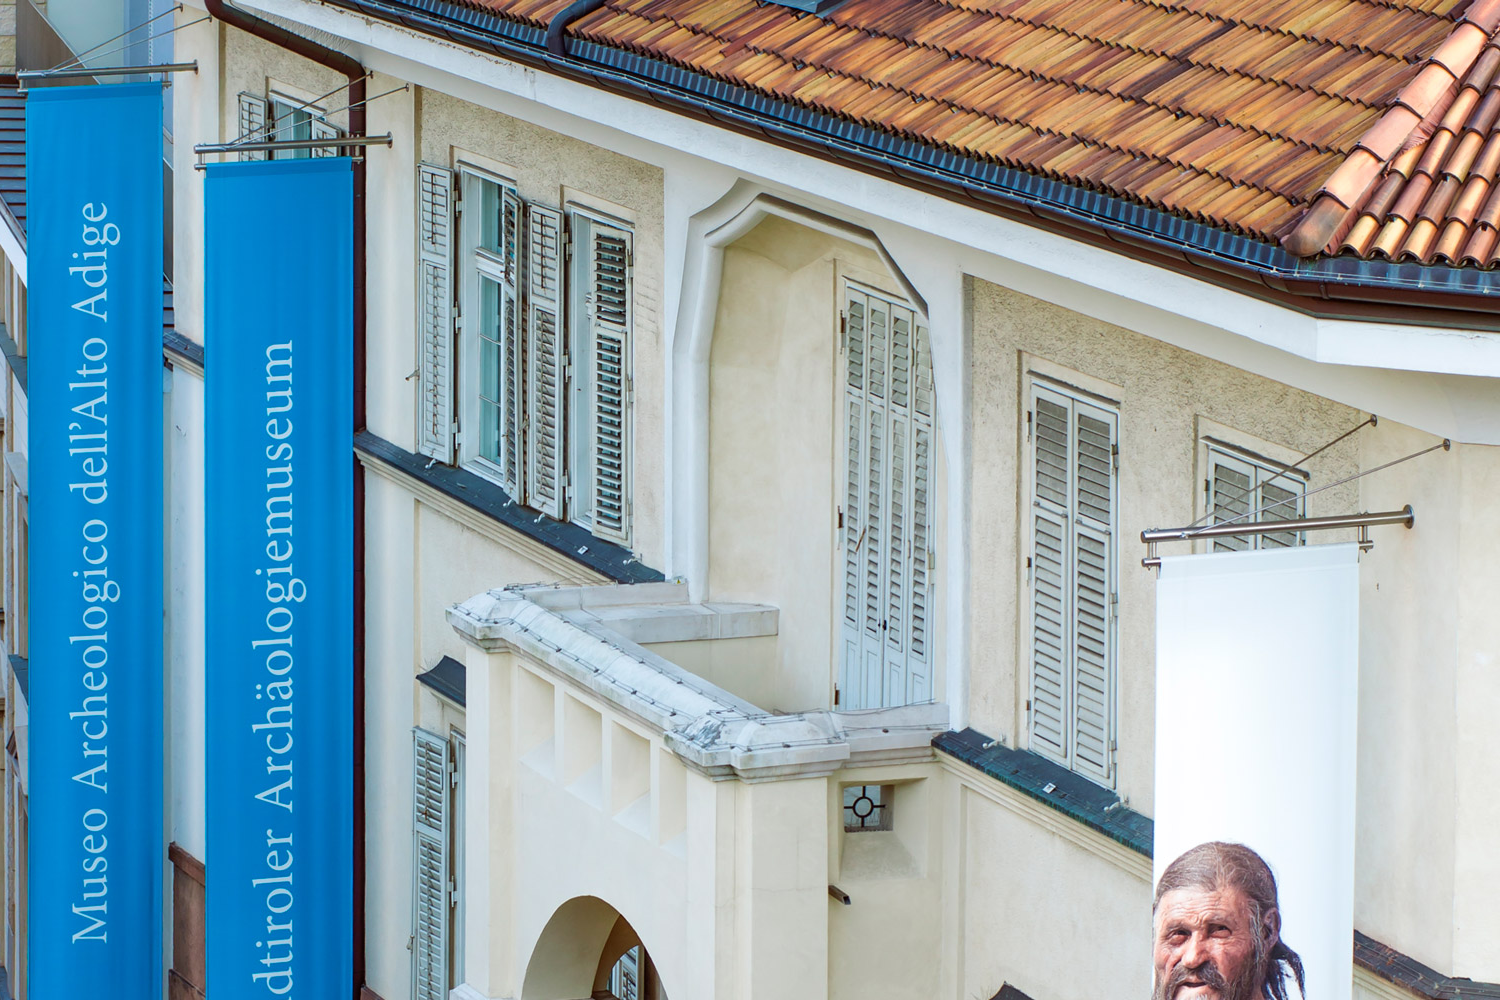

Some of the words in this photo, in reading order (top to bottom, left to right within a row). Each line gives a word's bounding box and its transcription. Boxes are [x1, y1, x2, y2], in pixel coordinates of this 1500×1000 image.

[68, 202, 121, 322] Adige
[69, 519, 121, 793] Archeologico
[251, 340, 307, 813] Archäologiemuseum
[72, 808, 108, 944] Museo
